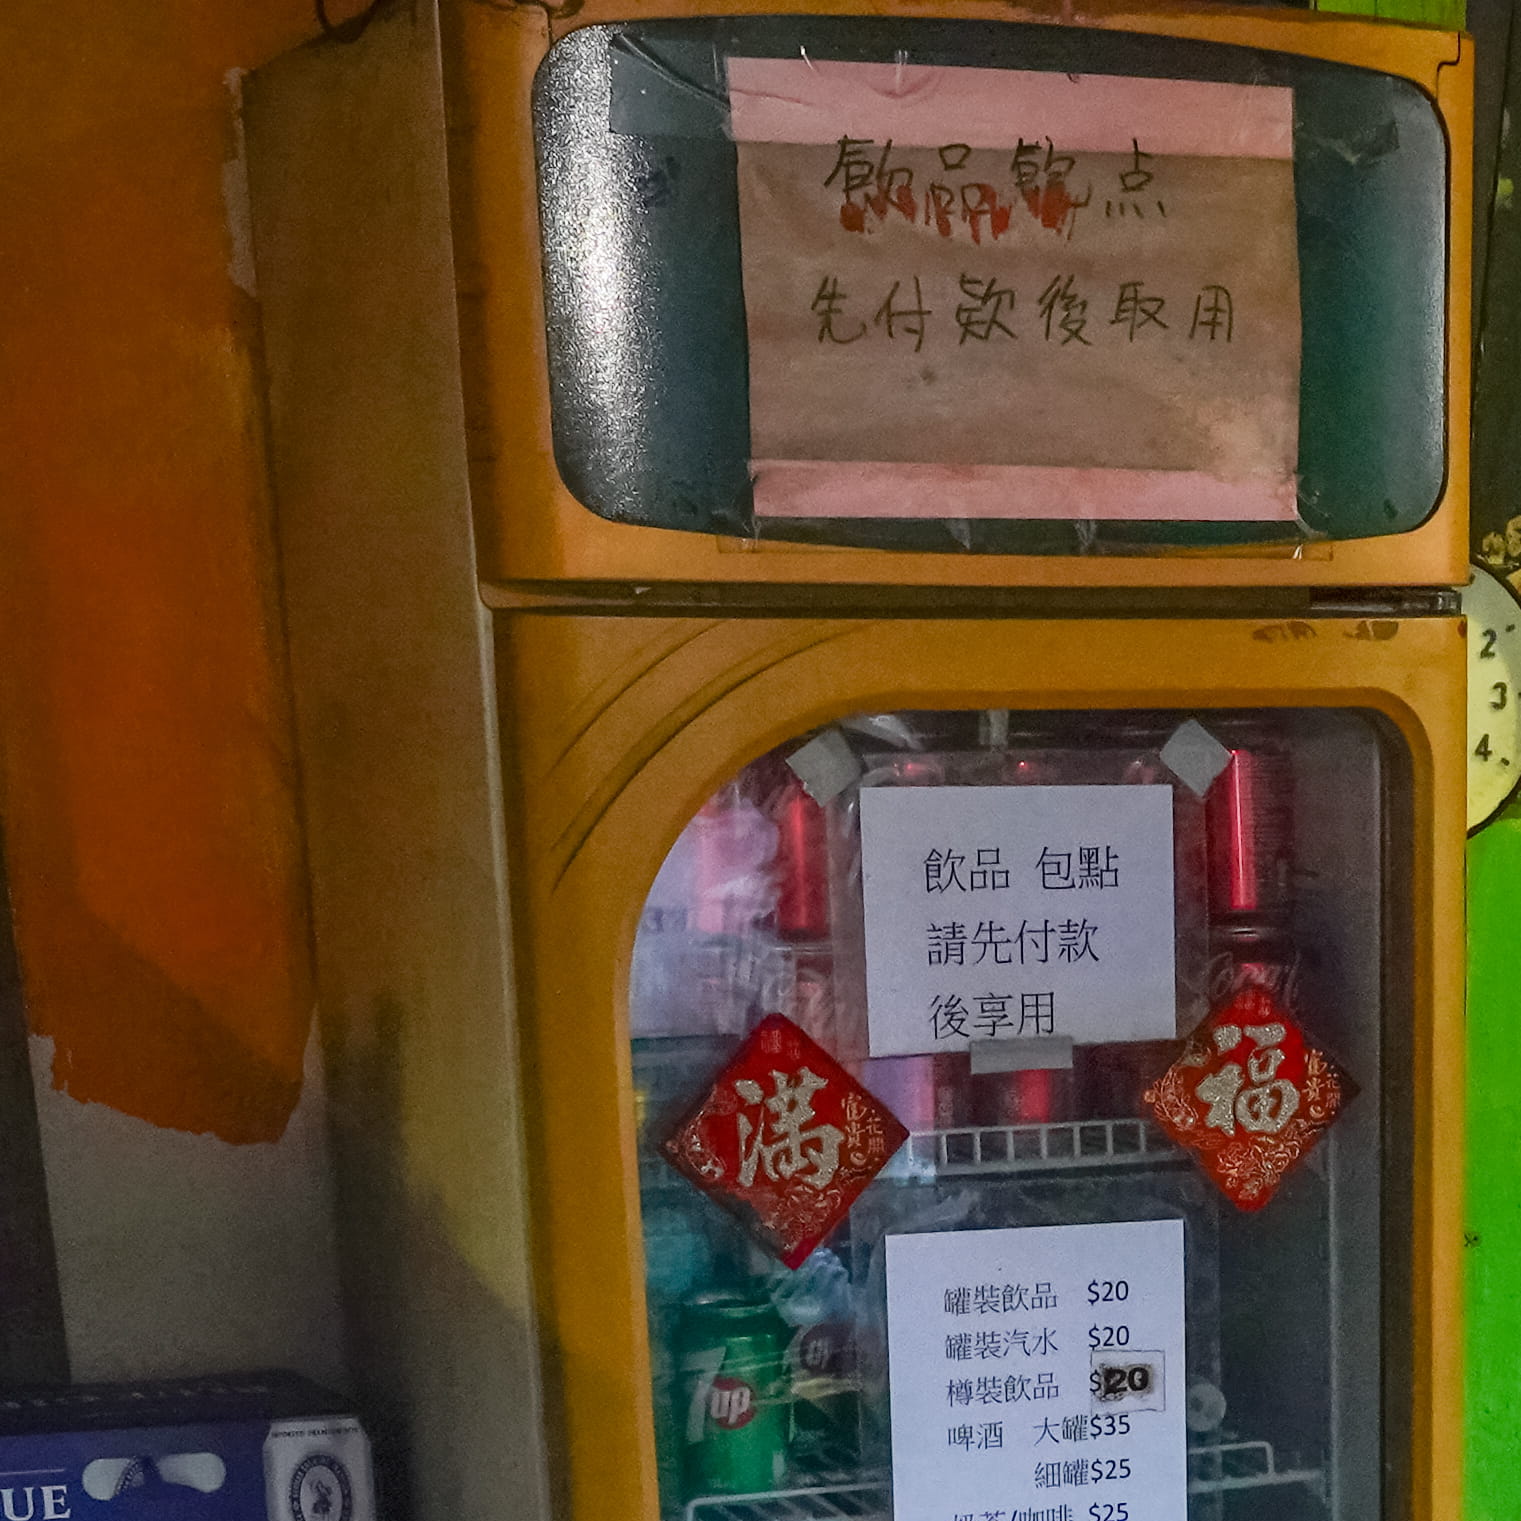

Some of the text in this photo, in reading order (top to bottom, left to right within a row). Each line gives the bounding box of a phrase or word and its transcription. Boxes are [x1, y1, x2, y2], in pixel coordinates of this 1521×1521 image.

[1480, 629, 1497, 659] 2
[1489, 682, 1508, 711] 3
[1474, 734, 1492, 762] 4
[923, 845, 1120, 893] 飲品 包點
[926, 919, 1099, 966] 請先付款
[929, 992, 1056, 1040] 後享用
[1195, 1022, 1301, 1136] 福
[944, 1280, 1129, 1316] 罐裝飲品 $20
[945, 1326, 1130, 1361] 罐裝汽水 $20
[946, 1373, 1059, 1406] 樽裝飲品
[948, 1421, 1003, 1451] 啤酒
